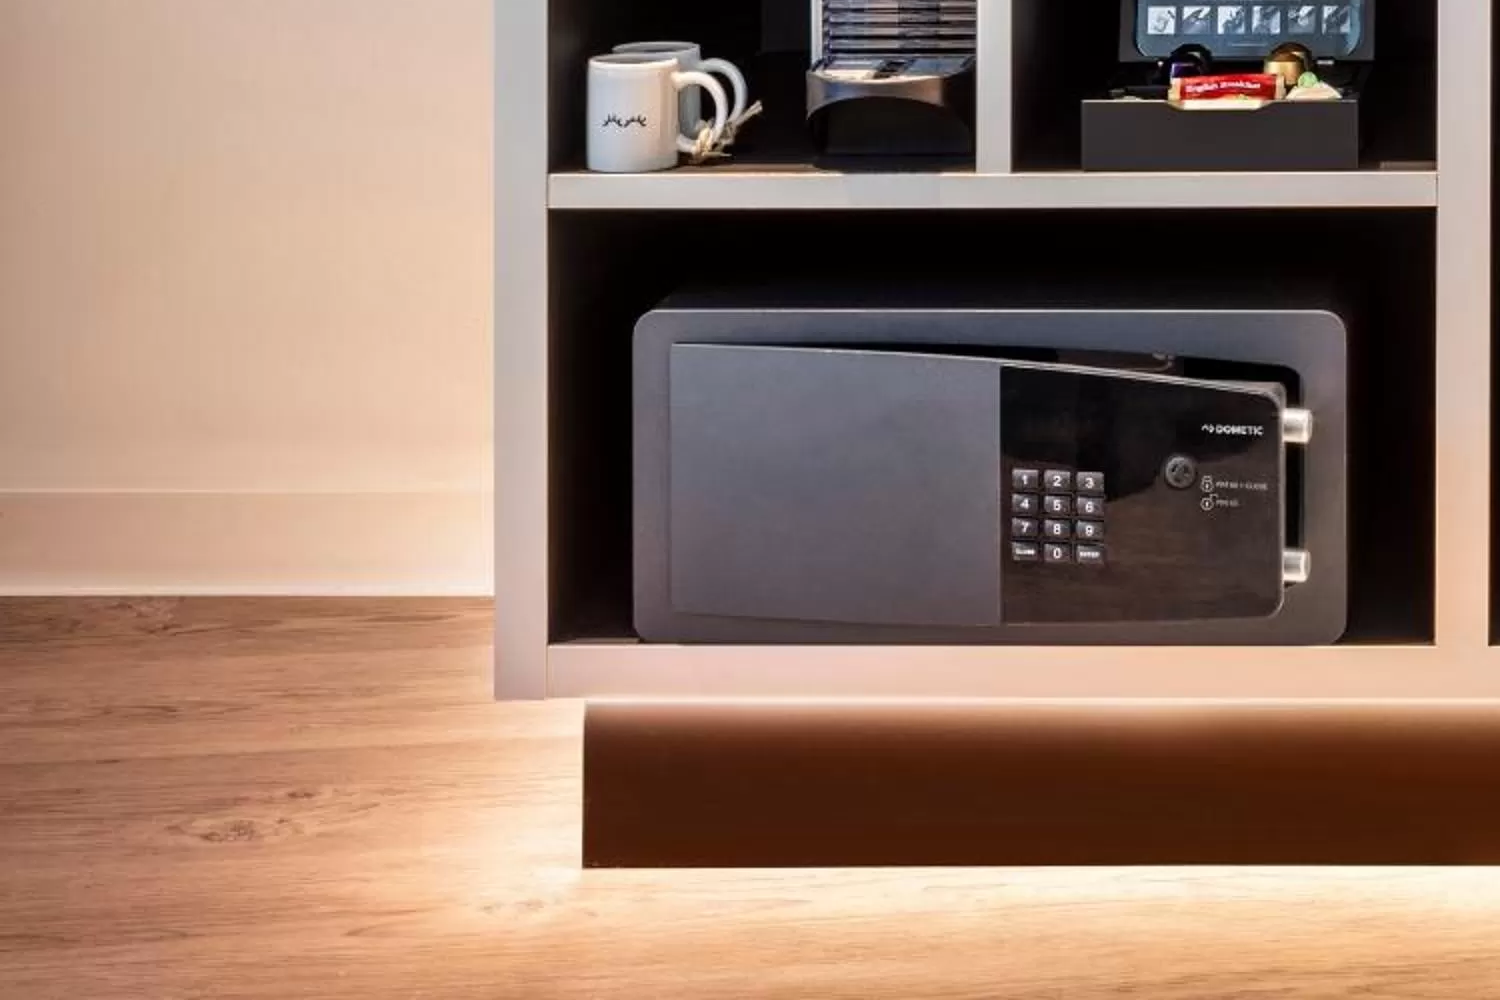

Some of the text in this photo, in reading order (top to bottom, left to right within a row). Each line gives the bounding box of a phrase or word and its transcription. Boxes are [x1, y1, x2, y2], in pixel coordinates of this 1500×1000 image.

[1215, 424, 1264, 436] DOMETIC
[1022, 474, 1028, 485] 1
[1053, 475, 1062, 487] 2
[1085, 477, 1095, 489] 3
[1020, 497, 1029, 509] 4
[1053, 499, 1061, 511] 5
[1085, 501, 1094, 513] 6
[1021, 521, 1029, 533] 7
[1053, 523, 1061, 535] 8
[1085, 525, 1094, 537] 9
[1053, 547, 1062, 559] 0
